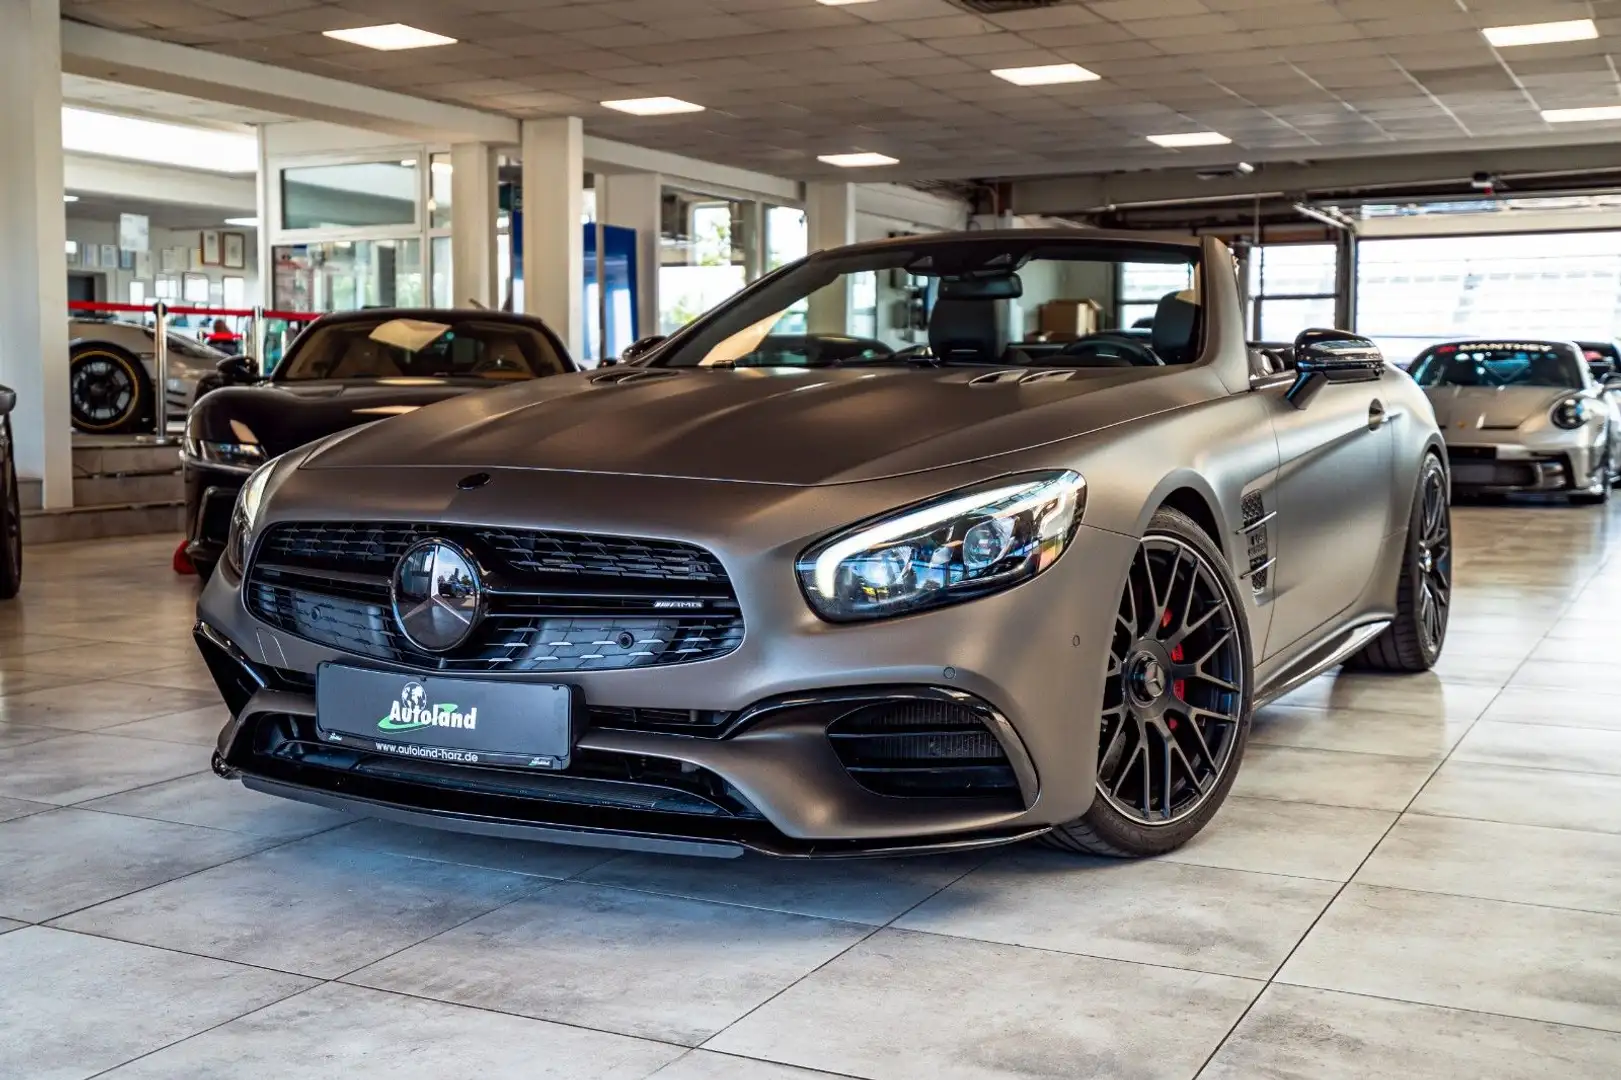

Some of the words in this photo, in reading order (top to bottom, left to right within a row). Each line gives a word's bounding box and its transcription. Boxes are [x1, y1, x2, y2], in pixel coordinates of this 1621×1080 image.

[1458, 343, 1552, 352] MANTHEY
[389, 700, 477, 729] Autoland
[375, 742, 479, 762] www.autoland-harz.de
